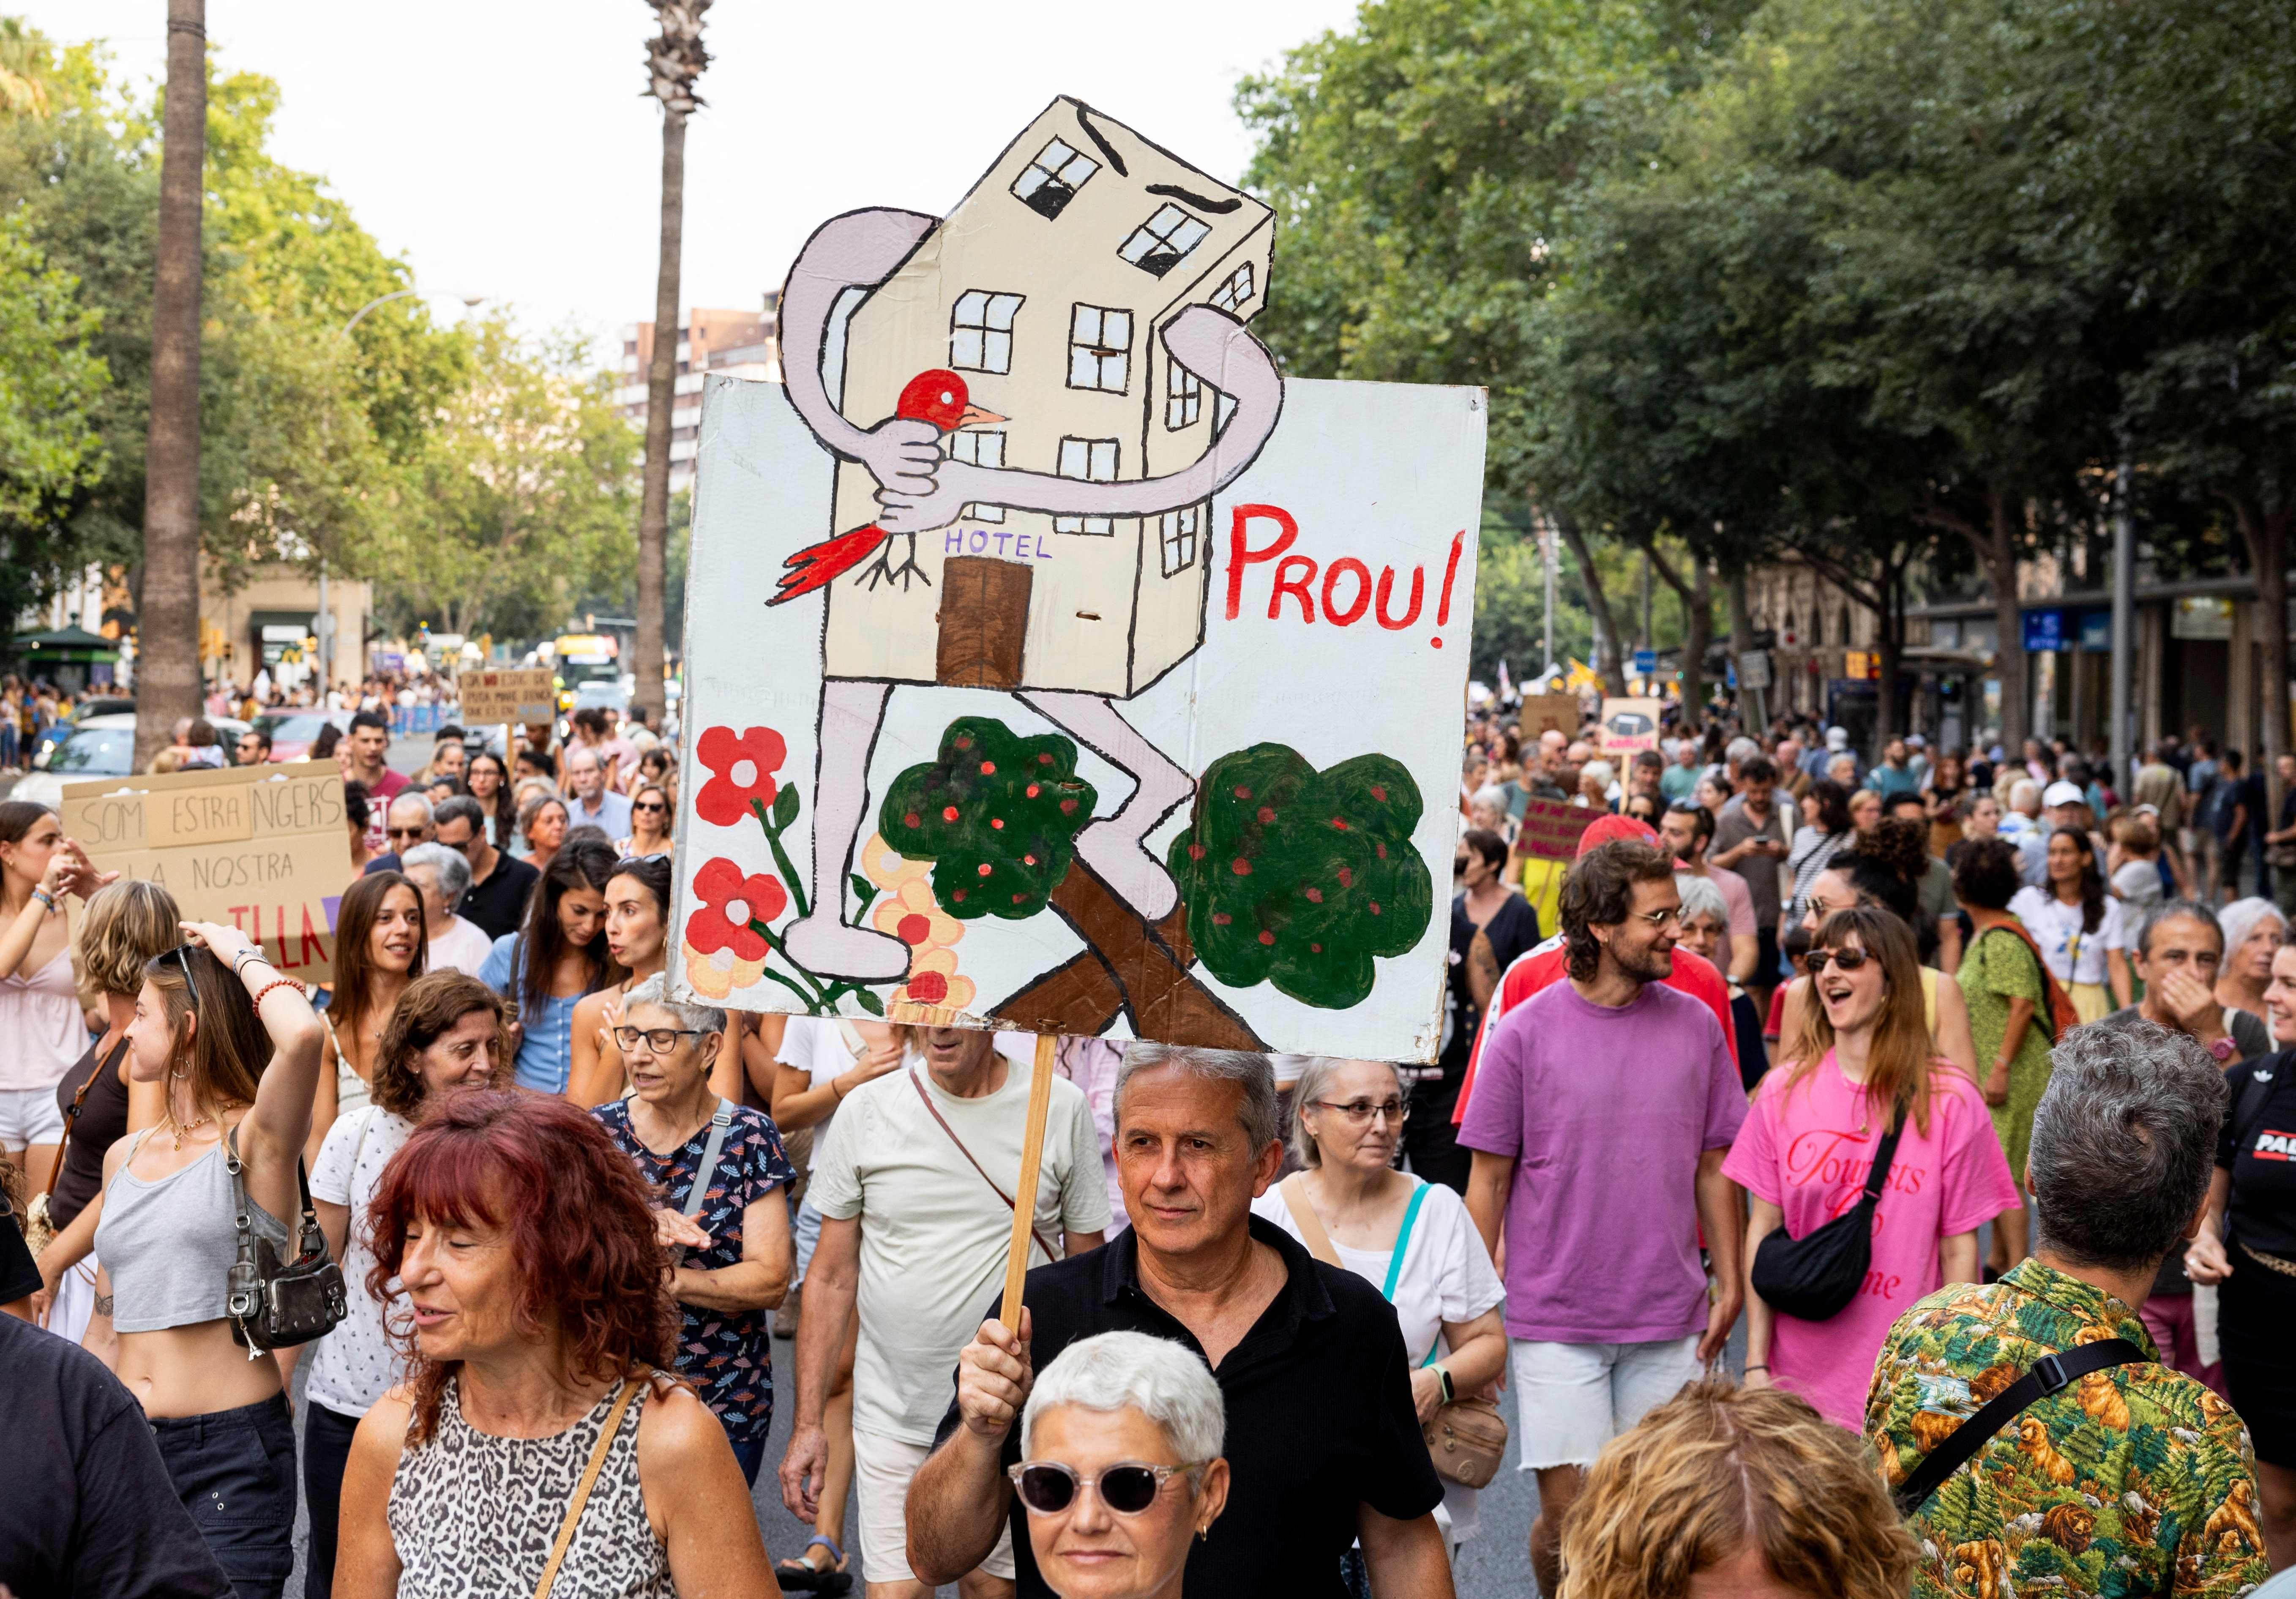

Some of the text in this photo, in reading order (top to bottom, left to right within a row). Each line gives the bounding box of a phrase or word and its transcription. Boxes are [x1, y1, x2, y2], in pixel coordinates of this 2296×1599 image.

[945, 529, 1052, 559] HOTEL
[1225, 503, 1466, 649] PROU!
[483, 674, 498, 687] NO
[82, 801, 143, 845] SOM
[193, 853, 293, 890] NOSTRA
[1787, 1129, 1926, 1195] Toursts
